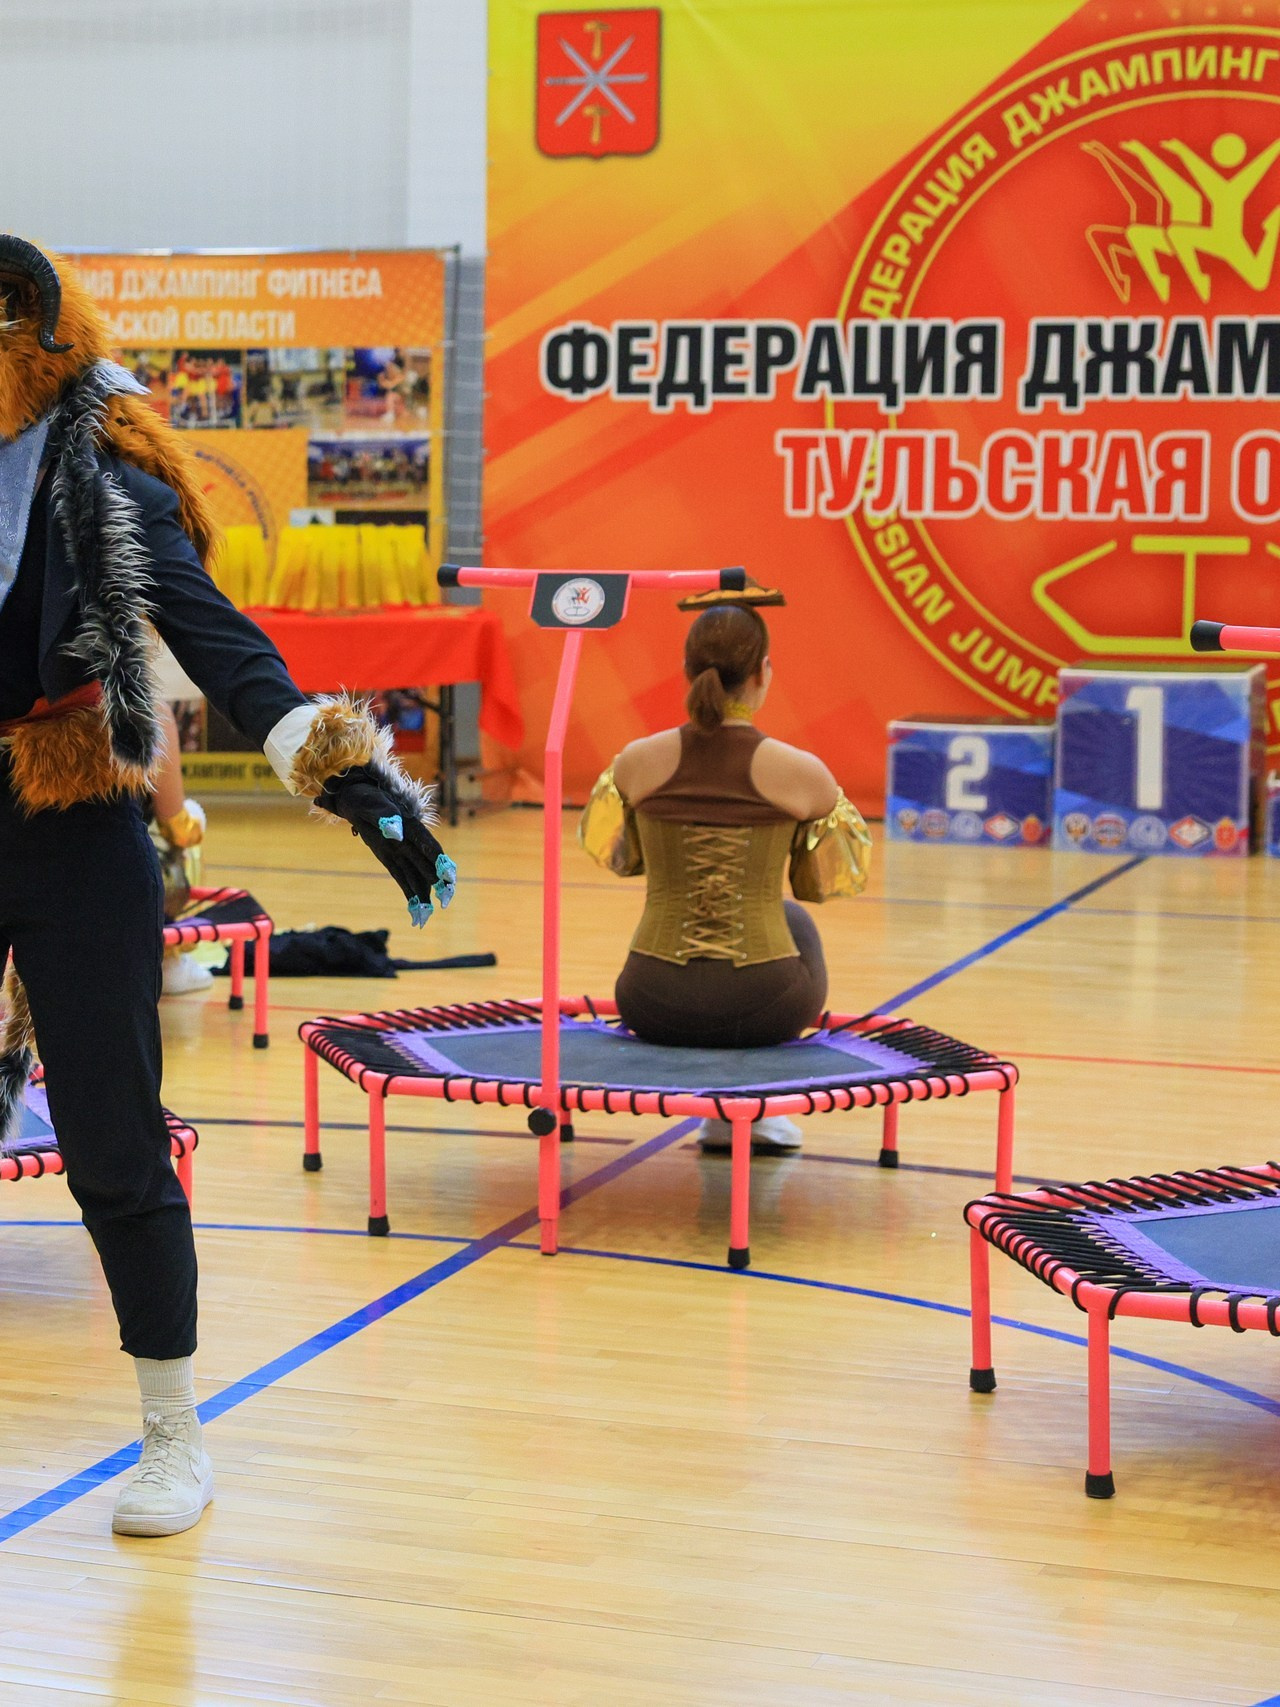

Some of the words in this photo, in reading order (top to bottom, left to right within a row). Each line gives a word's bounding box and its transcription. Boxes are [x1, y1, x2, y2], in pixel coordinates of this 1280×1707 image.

[859, 133, 997, 320] ДЕРАЦИЯ
[1001, 46, 1279, 147] ДЖАМПИНГ
[120, 268, 262, 301] ДЖАМПИНГ
[267, 267, 383, 298] ФИТНЕСА
[185, 309, 296, 341] ОБЛАСТИ
[543, 321, 999, 410] ФЕДЕРАЦИЯ
[779, 431, 1208, 518] ТУЛЬСКАЯ
[948, 627, 1058, 705] JUMP
[946, 736, 991, 811] 2
[1126, 686, 1163, 809] 1
